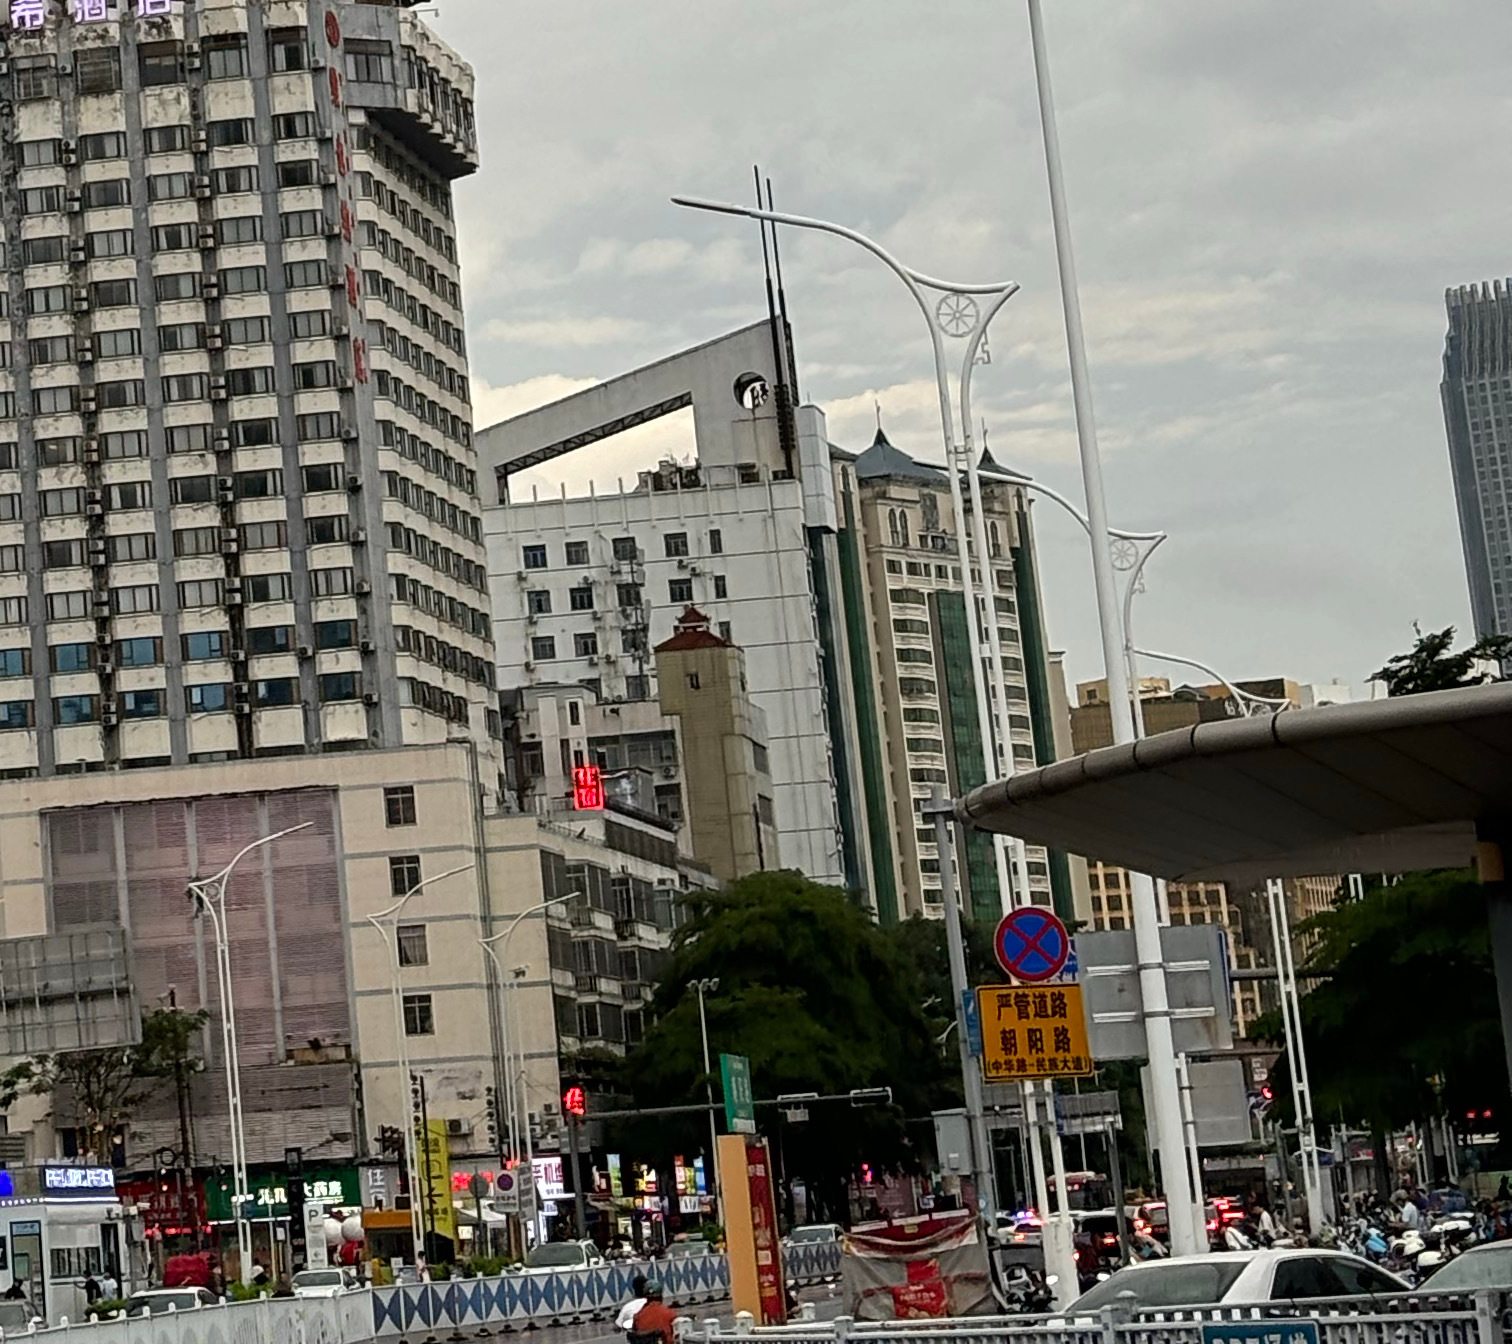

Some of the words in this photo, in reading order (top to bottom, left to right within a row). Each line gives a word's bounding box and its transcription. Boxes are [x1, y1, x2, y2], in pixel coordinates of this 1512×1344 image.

[996, 991, 1068, 1021] 严管道路
[1000, 1025, 1071, 1057] 朝阳路
